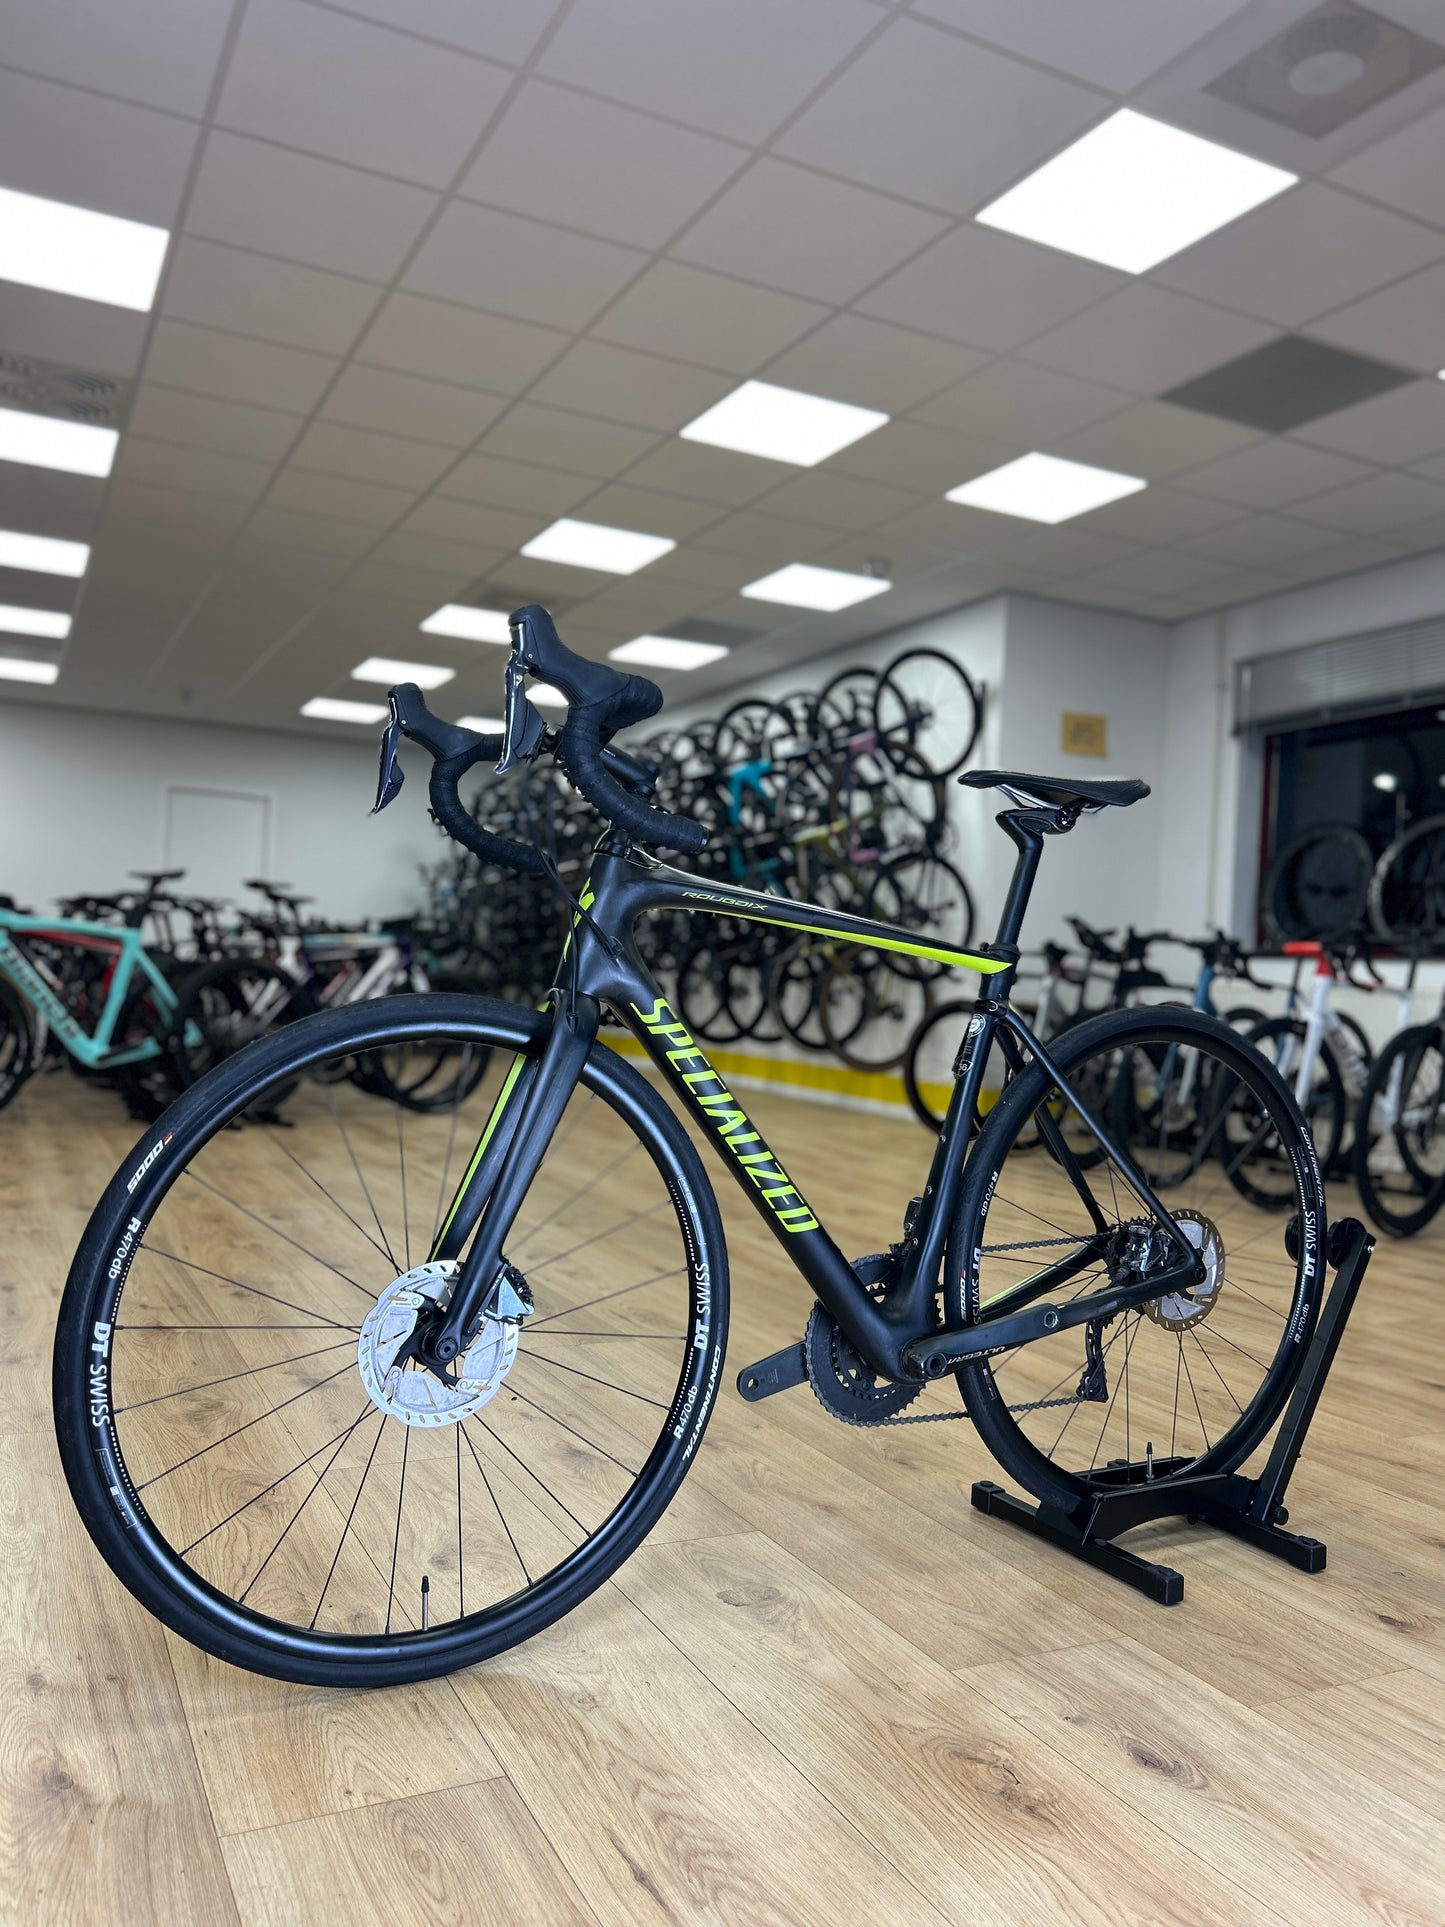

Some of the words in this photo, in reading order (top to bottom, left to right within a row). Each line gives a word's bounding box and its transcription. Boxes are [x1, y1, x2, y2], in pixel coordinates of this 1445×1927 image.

[630, 998, 819, 1233] SPECIALIZED
[127, 1139, 164, 1194] 5000
[1300, 1126, 1325, 1207] CONTINENTAL
[1304, 1210, 1317, 1251] SWISS
[694, 1262, 711, 1315] SWISS
[1304, 1253, 1316, 1277] DT
[971, 1278, 982, 1325] SWISS
[91, 1321, 111, 1358] DT
[694, 1319, 710, 1351] DT
[947, 1346, 1006, 1365] ULTEGRA
[90, 1363, 111, 1428] SWISS
[682, 1345, 721, 1462] CONTINENTAL
